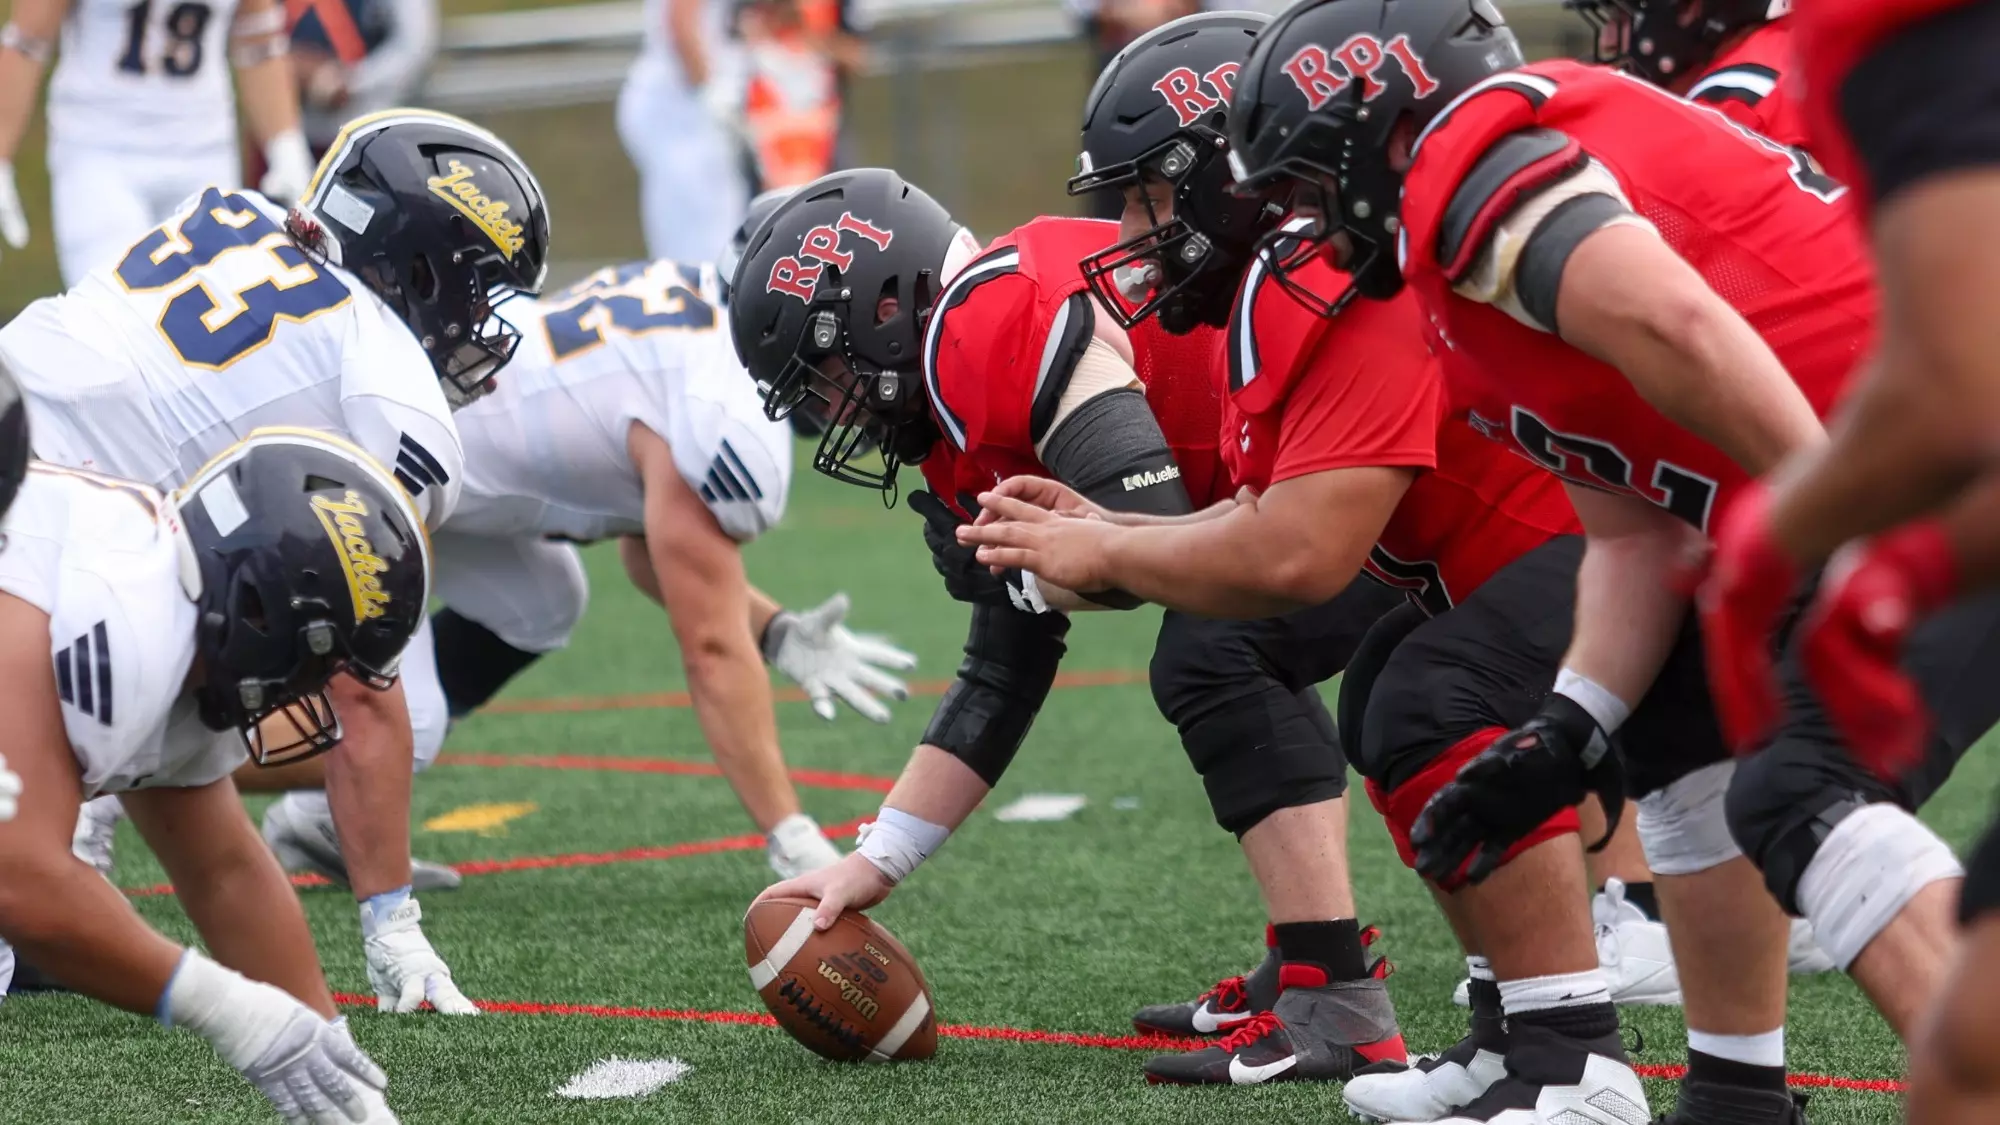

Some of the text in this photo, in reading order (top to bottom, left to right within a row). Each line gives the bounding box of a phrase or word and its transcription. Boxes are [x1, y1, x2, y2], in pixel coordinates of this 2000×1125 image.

[1280, 32, 1440, 112] RPI
[427, 159, 525, 262] Jackets
[766, 211, 893, 305] RPI
[112, 184, 353, 373] 33
[309, 490, 391, 625] Jackets
[817, 960, 880, 1021] Wilson
